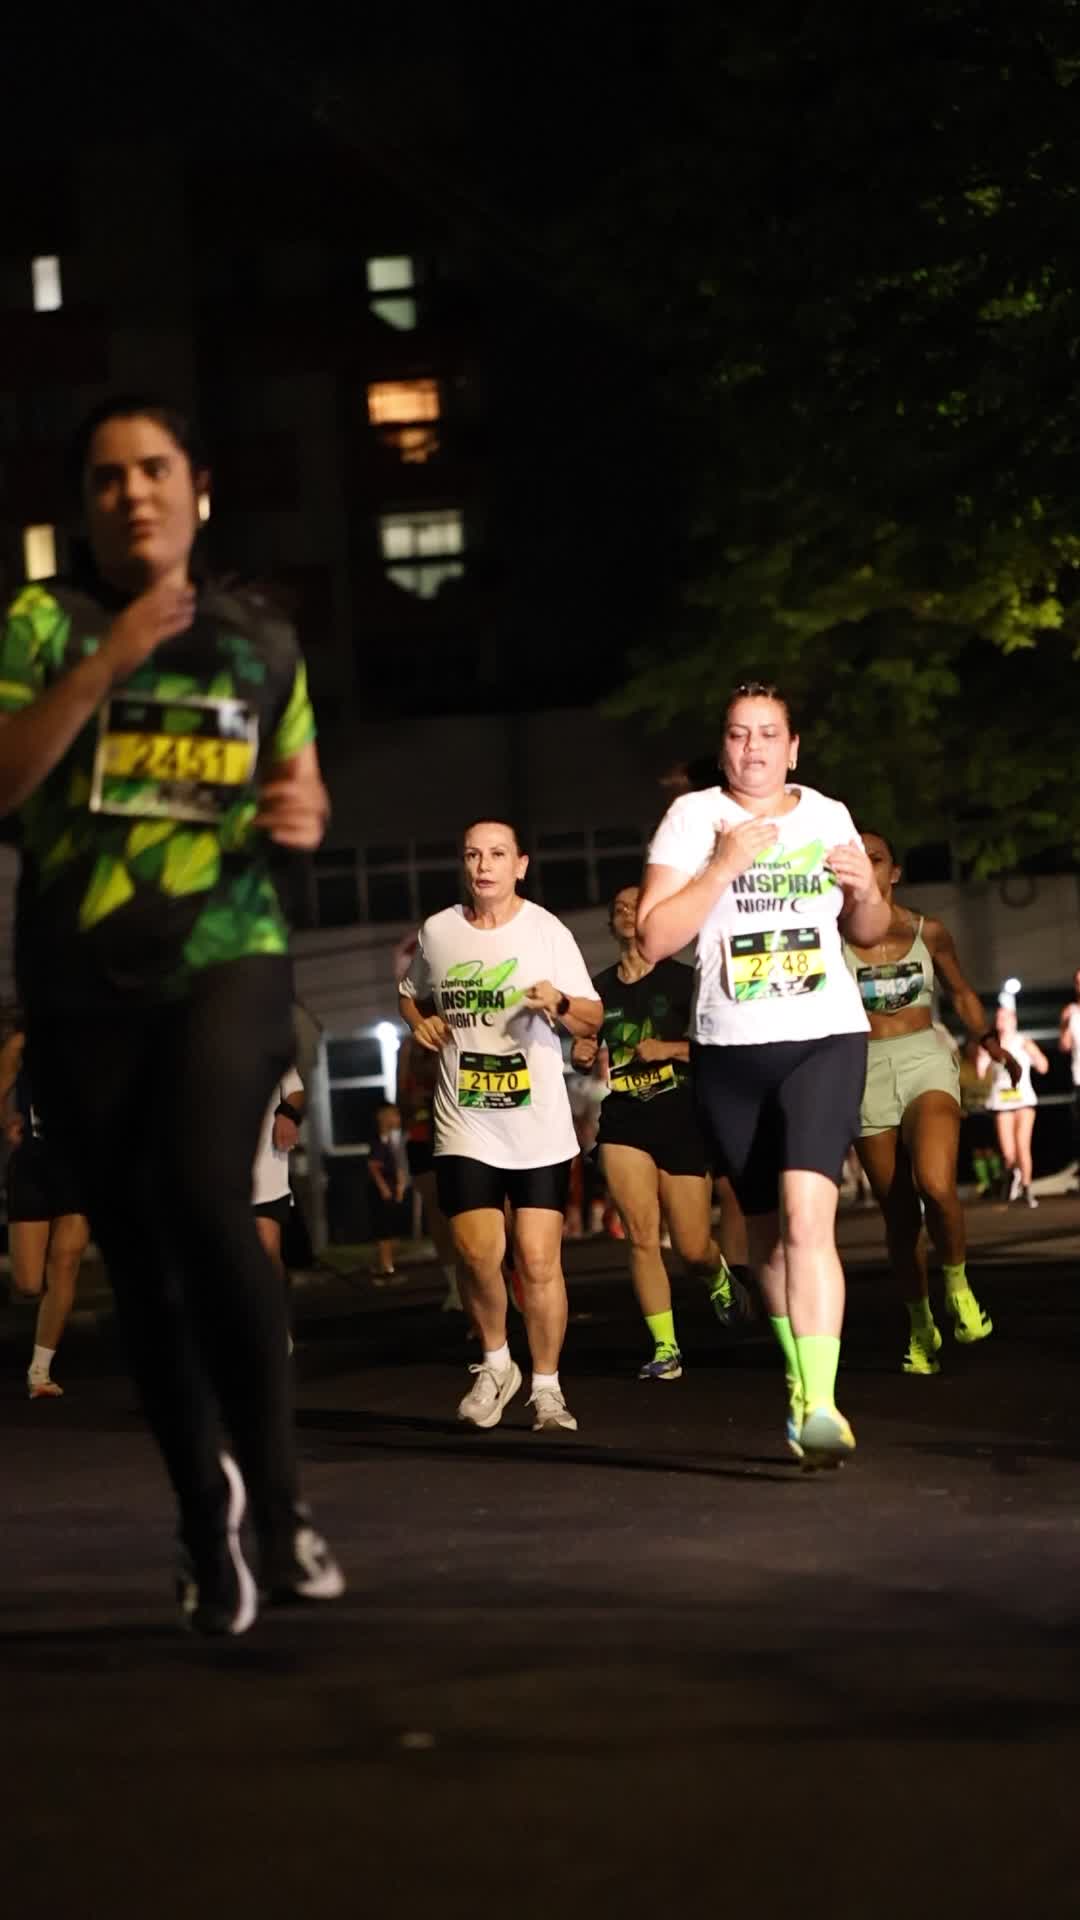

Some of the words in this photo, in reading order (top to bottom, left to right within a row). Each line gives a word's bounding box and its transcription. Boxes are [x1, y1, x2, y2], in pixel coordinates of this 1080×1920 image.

[732, 874, 822, 895] INSPIRA
[736, 898, 786, 913] NIGHT
[441, 990, 505, 1009] INSPIRA
[470, 1072, 519, 1091] 2170
[624, 1069, 662, 1089] 1694
